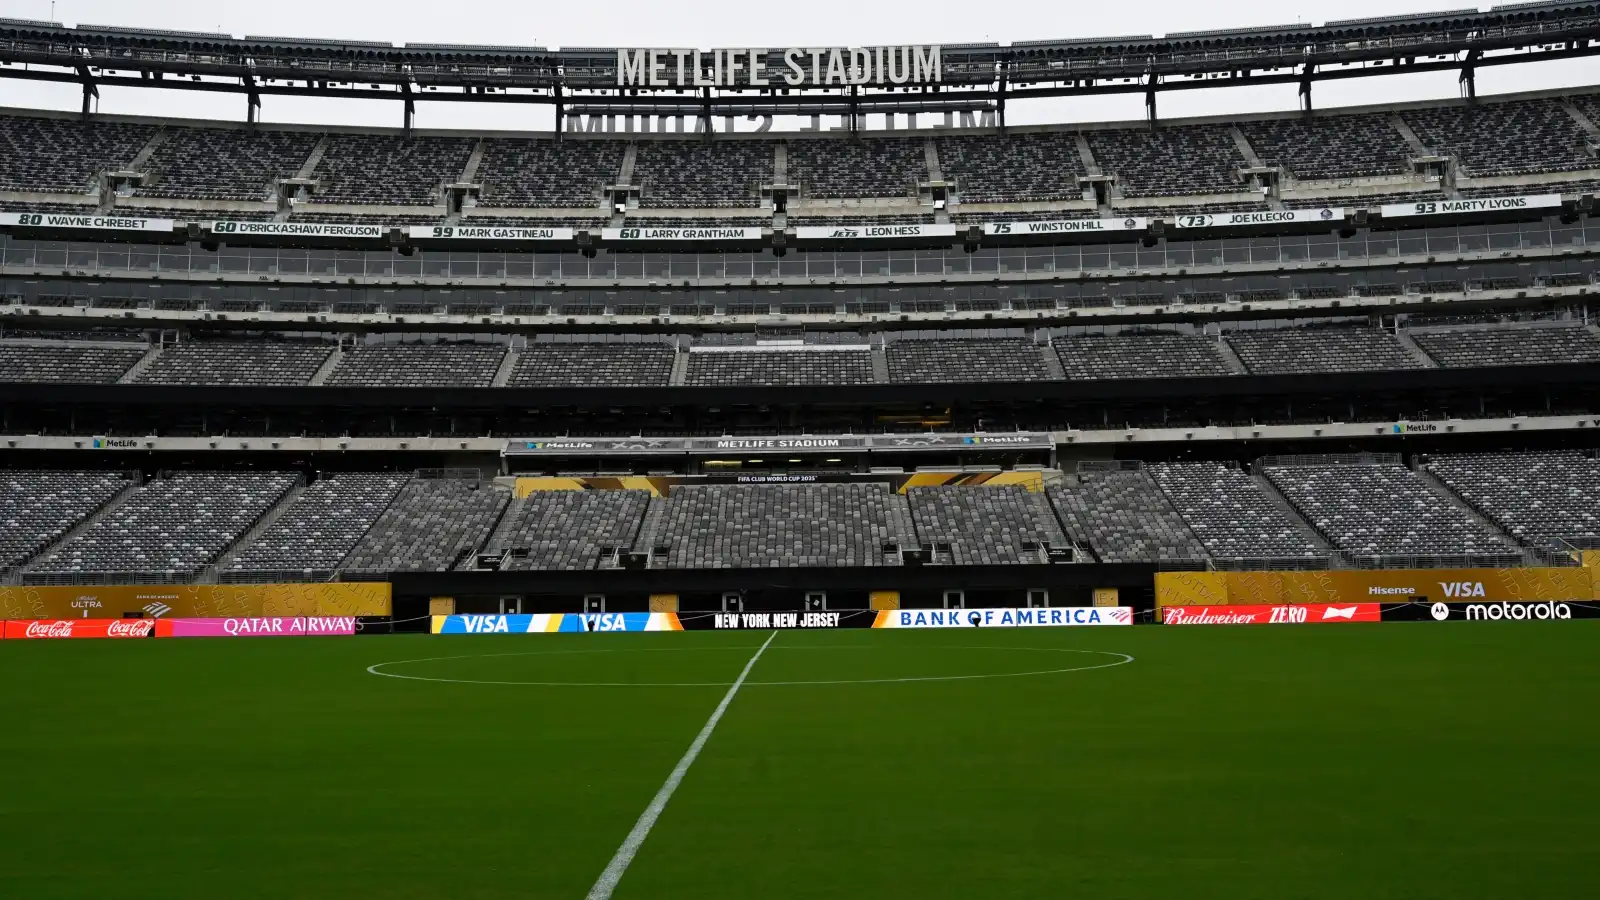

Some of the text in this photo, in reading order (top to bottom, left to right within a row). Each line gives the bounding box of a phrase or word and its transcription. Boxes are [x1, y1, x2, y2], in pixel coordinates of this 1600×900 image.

[617, 46, 941, 86] METLIFE STADIUM
[1415, 198, 1526, 214] 93 MARTY LYONS
[18, 214, 147, 229] 80 WAYNE CHREBET
[1187, 212, 1295, 227] 73 JOE KLECKO
[214, 222, 379, 236] 60 D'BRICKASHAW FERGUSON
[433, 227, 553, 238] 99 MARK GASTINEAU
[620, 229, 744, 239] 60 LARRY GRANTHAM
[829, 226, 920, 238] JETS LEON HESS
[993, 221, 1104, 234] 75 WINSTON HILL
[1406, 424, 1437, 432] MetLife
[718, 439, 839, 448] METLIFE STADIUM
[1369, 586, 1415, 595] Hisense
[1437, 582, 1486, 597] VISA
[900, 609, 1102, 626] BANK OF AMERICA
[1164, 607, 1308, 624] Budweiser ZERO
[1466, 601, 1572, 620] motorola
[224, 617, 364, 635] QATAR AIRWAYS
[460, 615, 509, 632] VISA
[579, 613, 626, 631] VISA
[714, 612, 840, 628] NEW YORK NEW JERSEY
[26, 620, 75, 637] Coca-Cola
